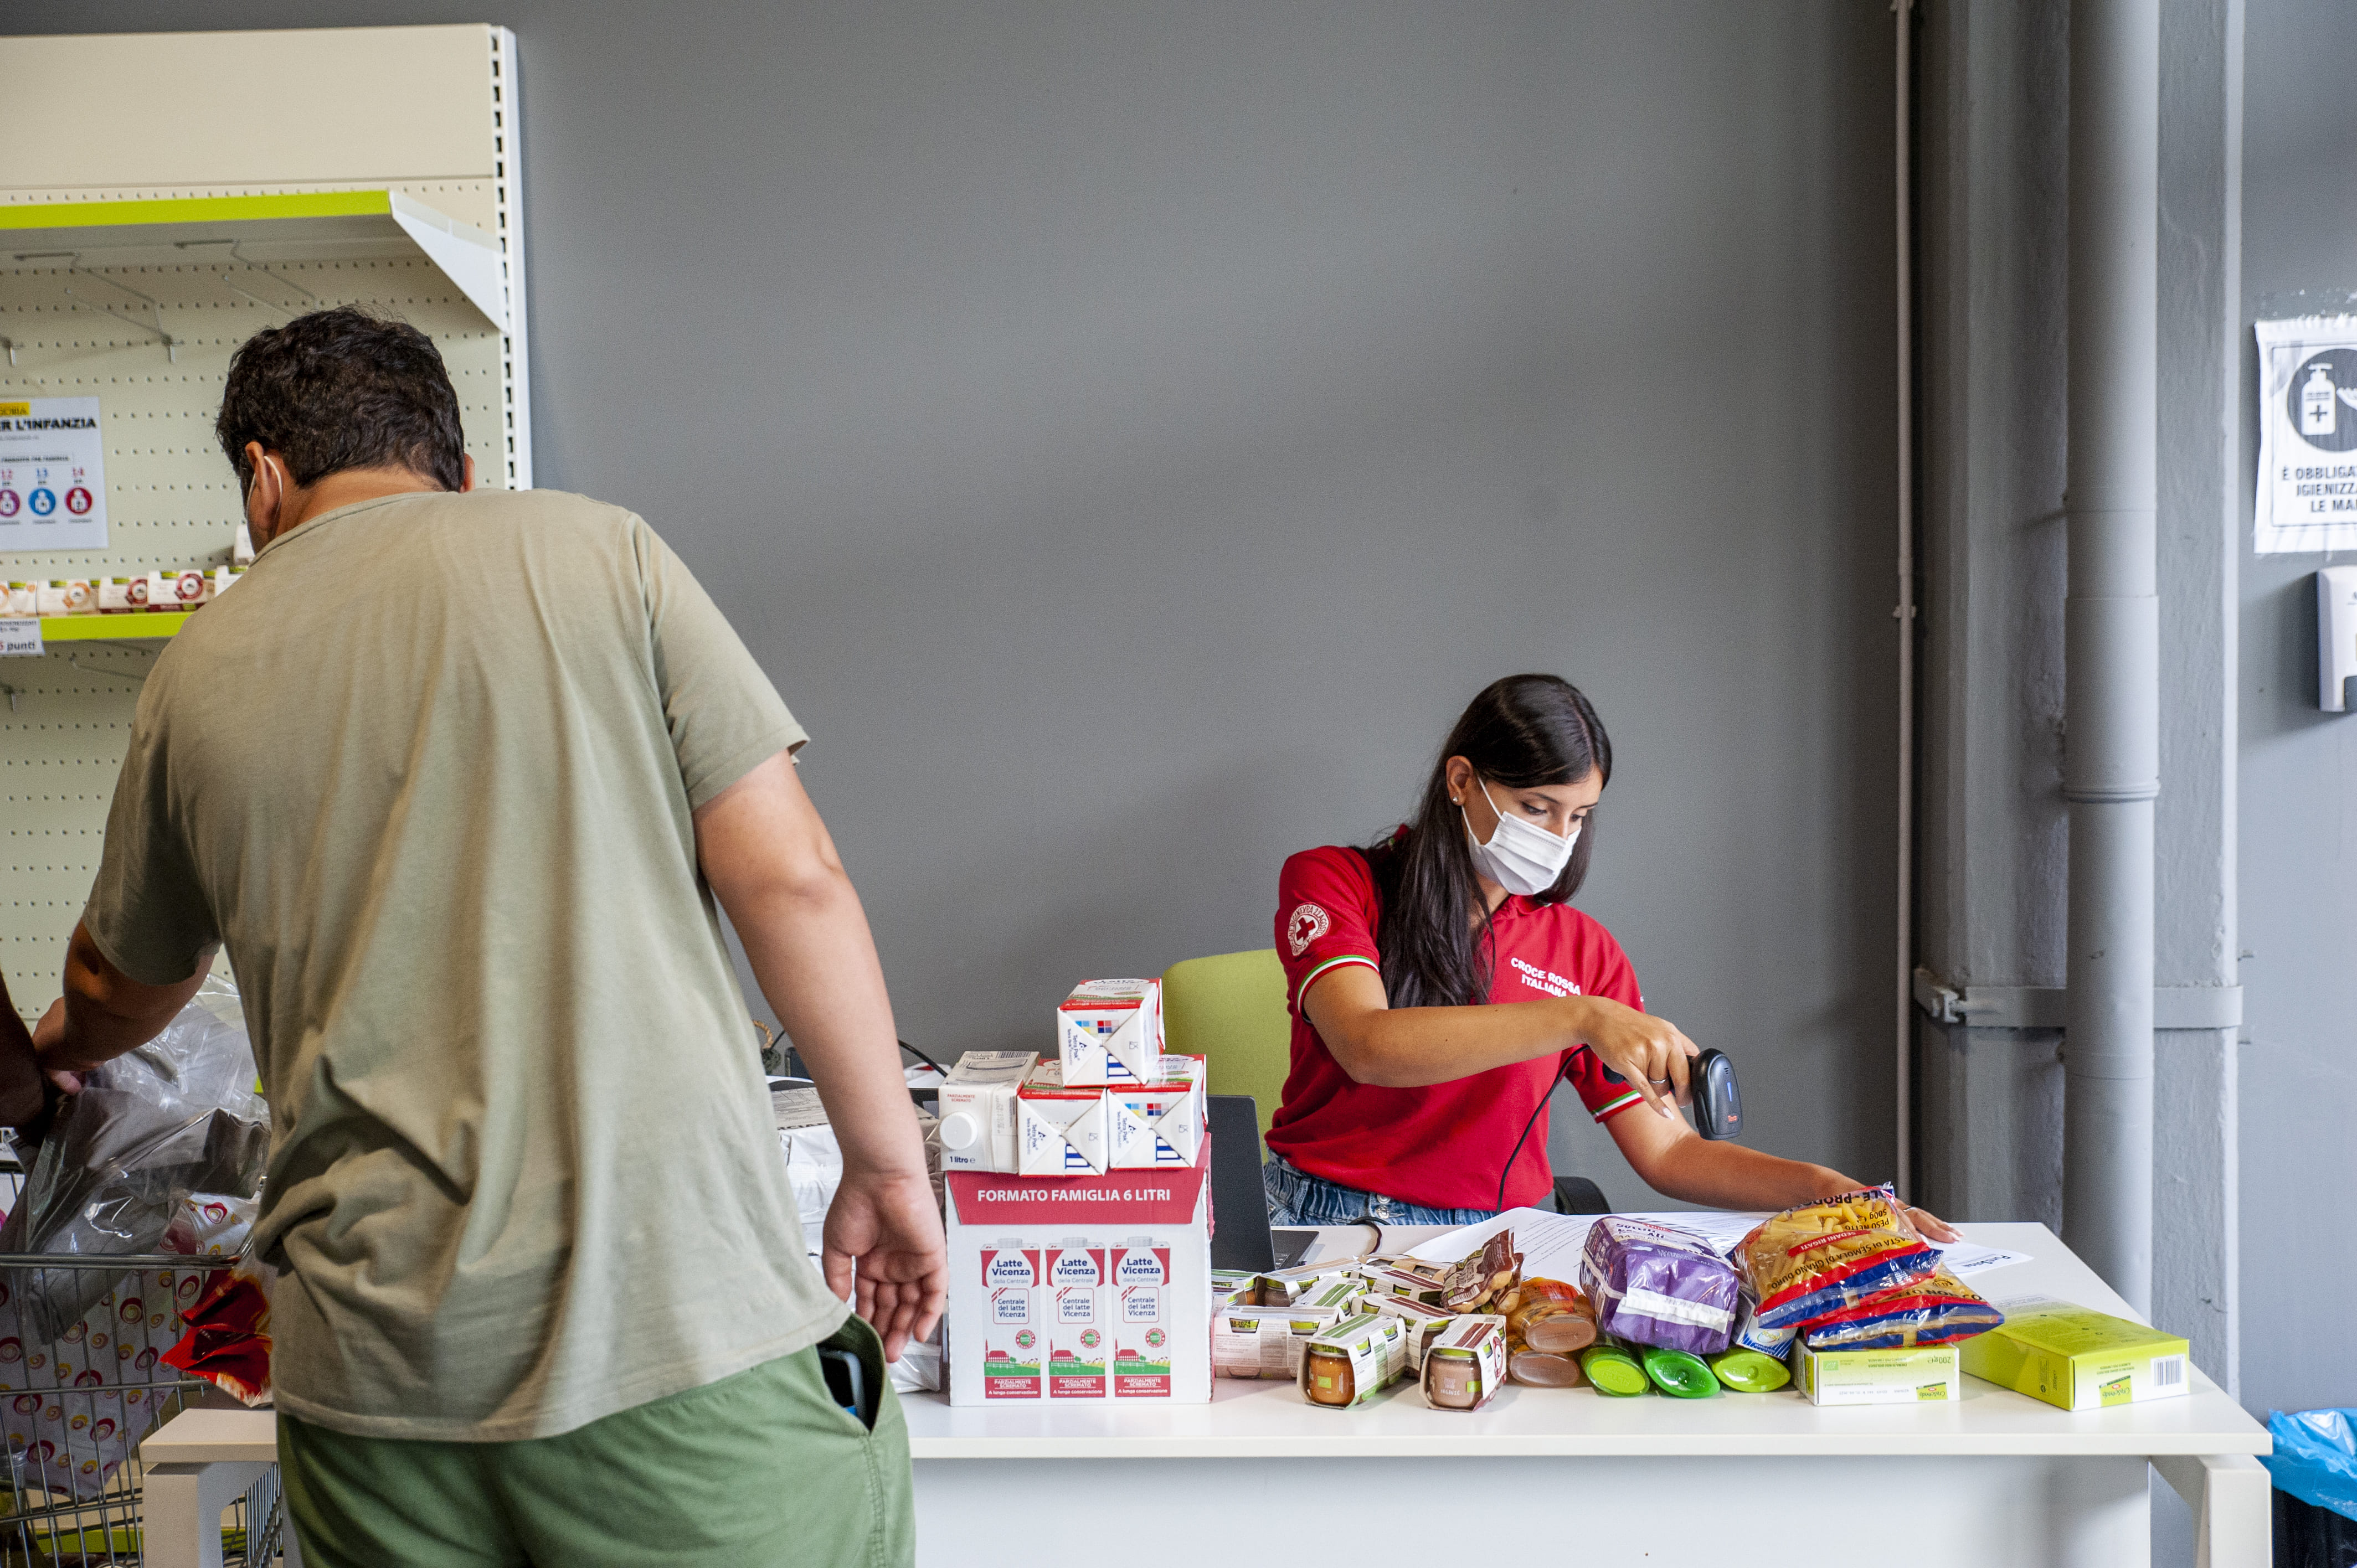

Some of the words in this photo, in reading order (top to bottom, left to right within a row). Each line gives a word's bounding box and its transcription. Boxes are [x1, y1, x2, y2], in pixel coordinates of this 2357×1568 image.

[16, 417, 97, 431] L'INFANZIA
[2296, 466, 2357, 480] OBBLIGA
[2311, 500, 2325, 513] LE
[2332, 499, 2357, 512] MA
[7, 639, 35, 652] punti
[1511, 957, 1546, 979] CROCE
[1548, 972, 1581, 996] ROSSA
[1521, 974, 1567, 997] ITALIANA
[977, 1189, 1048, 1201] FORMATO
[1051, 1189, 1120, 1201] FAMIGLIA
[1123, 1189, 1132, 1201] 6
[1136, 1189, 1170, 1201] LITRI
[1869, 1208, 1887, 1220] 500g
[1871, 1218, 1890, 1229] PESO
[1827, 1231, 1857, 1241] SEDANI
[1800, 1237, 1826, 1251] RIGATI
[1836, 1244, 1872, 1260] SEMOLA
[1825, 1255, 1835, 1264] DI
[1794, 1258, 1824, 1276] GRANO
[1771, 1271, 1796, 1290] DURO
